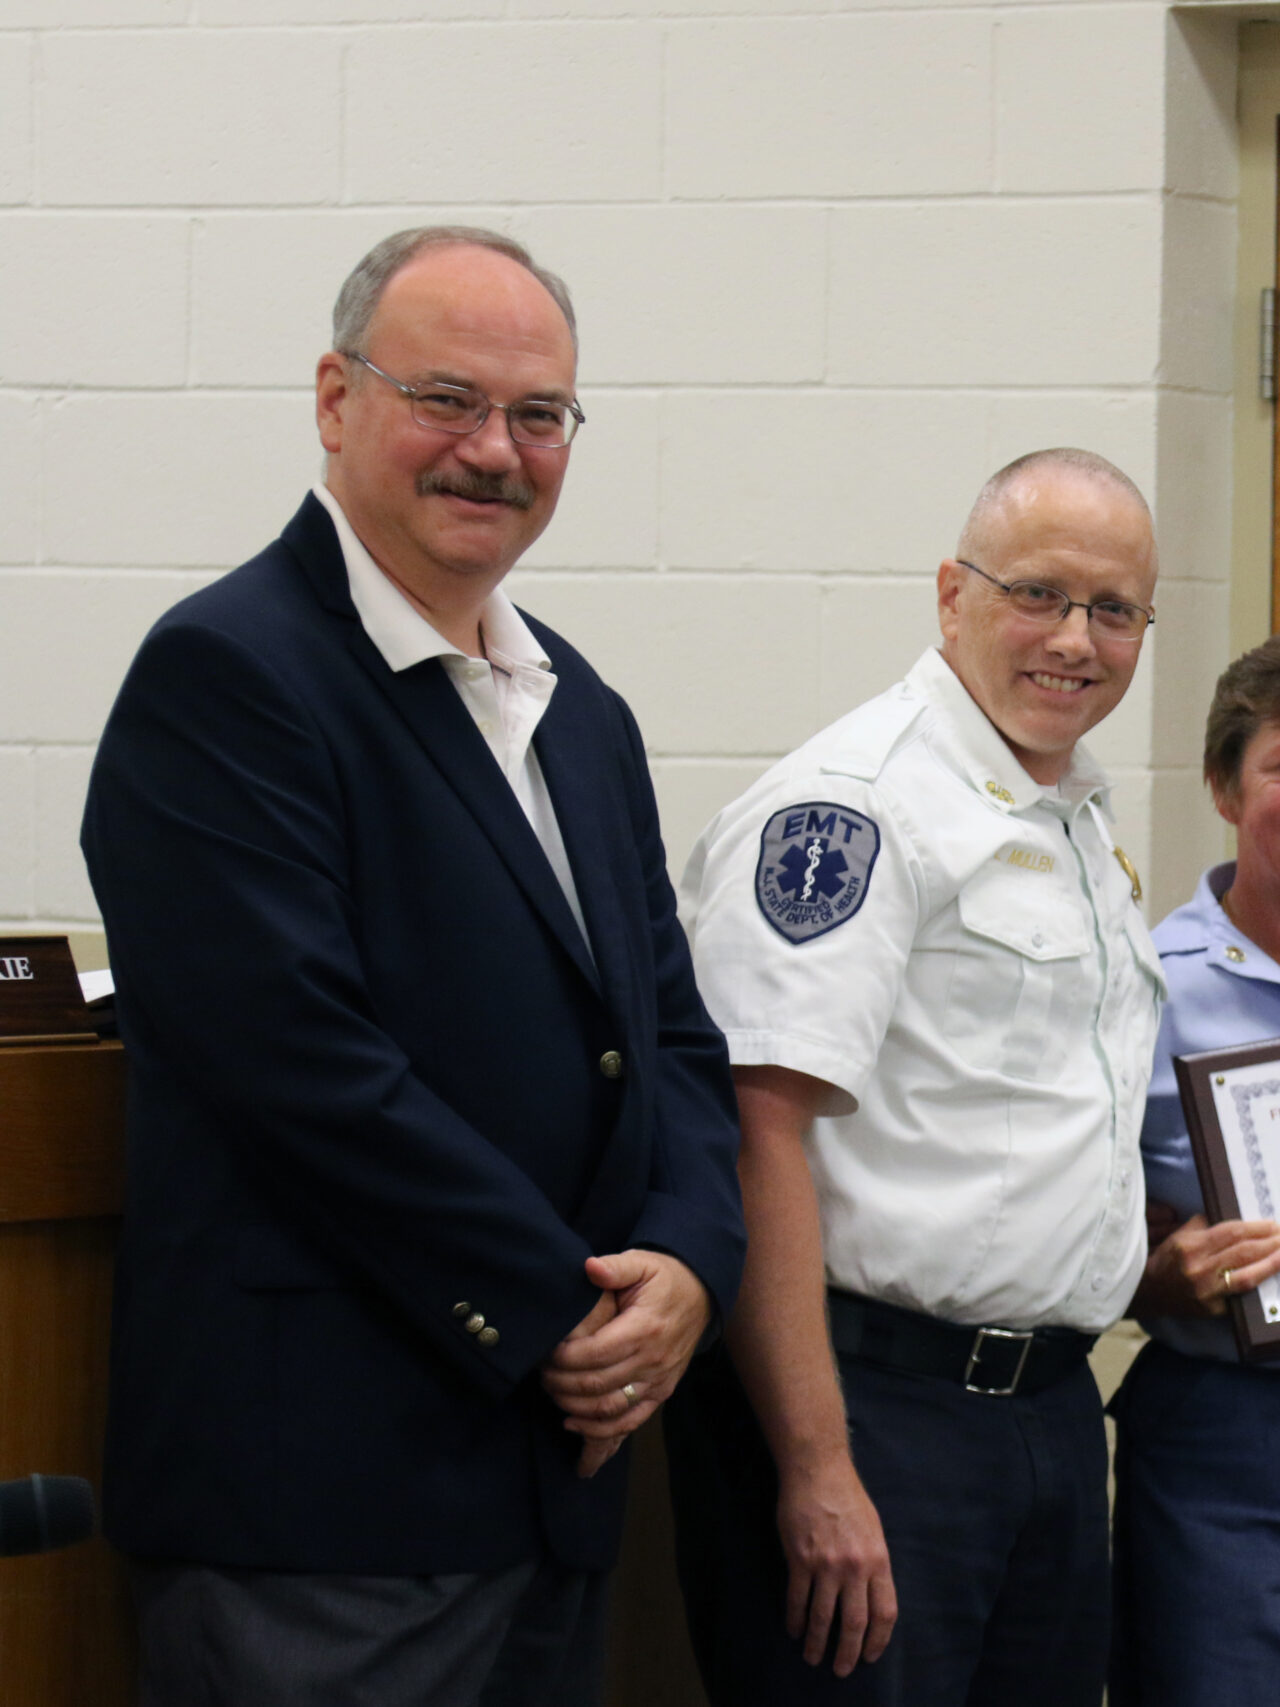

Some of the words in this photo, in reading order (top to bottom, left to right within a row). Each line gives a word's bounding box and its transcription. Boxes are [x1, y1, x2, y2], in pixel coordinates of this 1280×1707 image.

[782, 810, 862, 844] EMT
[765, 888, 785, 917] STATE
[820, 909, 833, 922] OF
[834, 876, 860, 913] HEALTH
